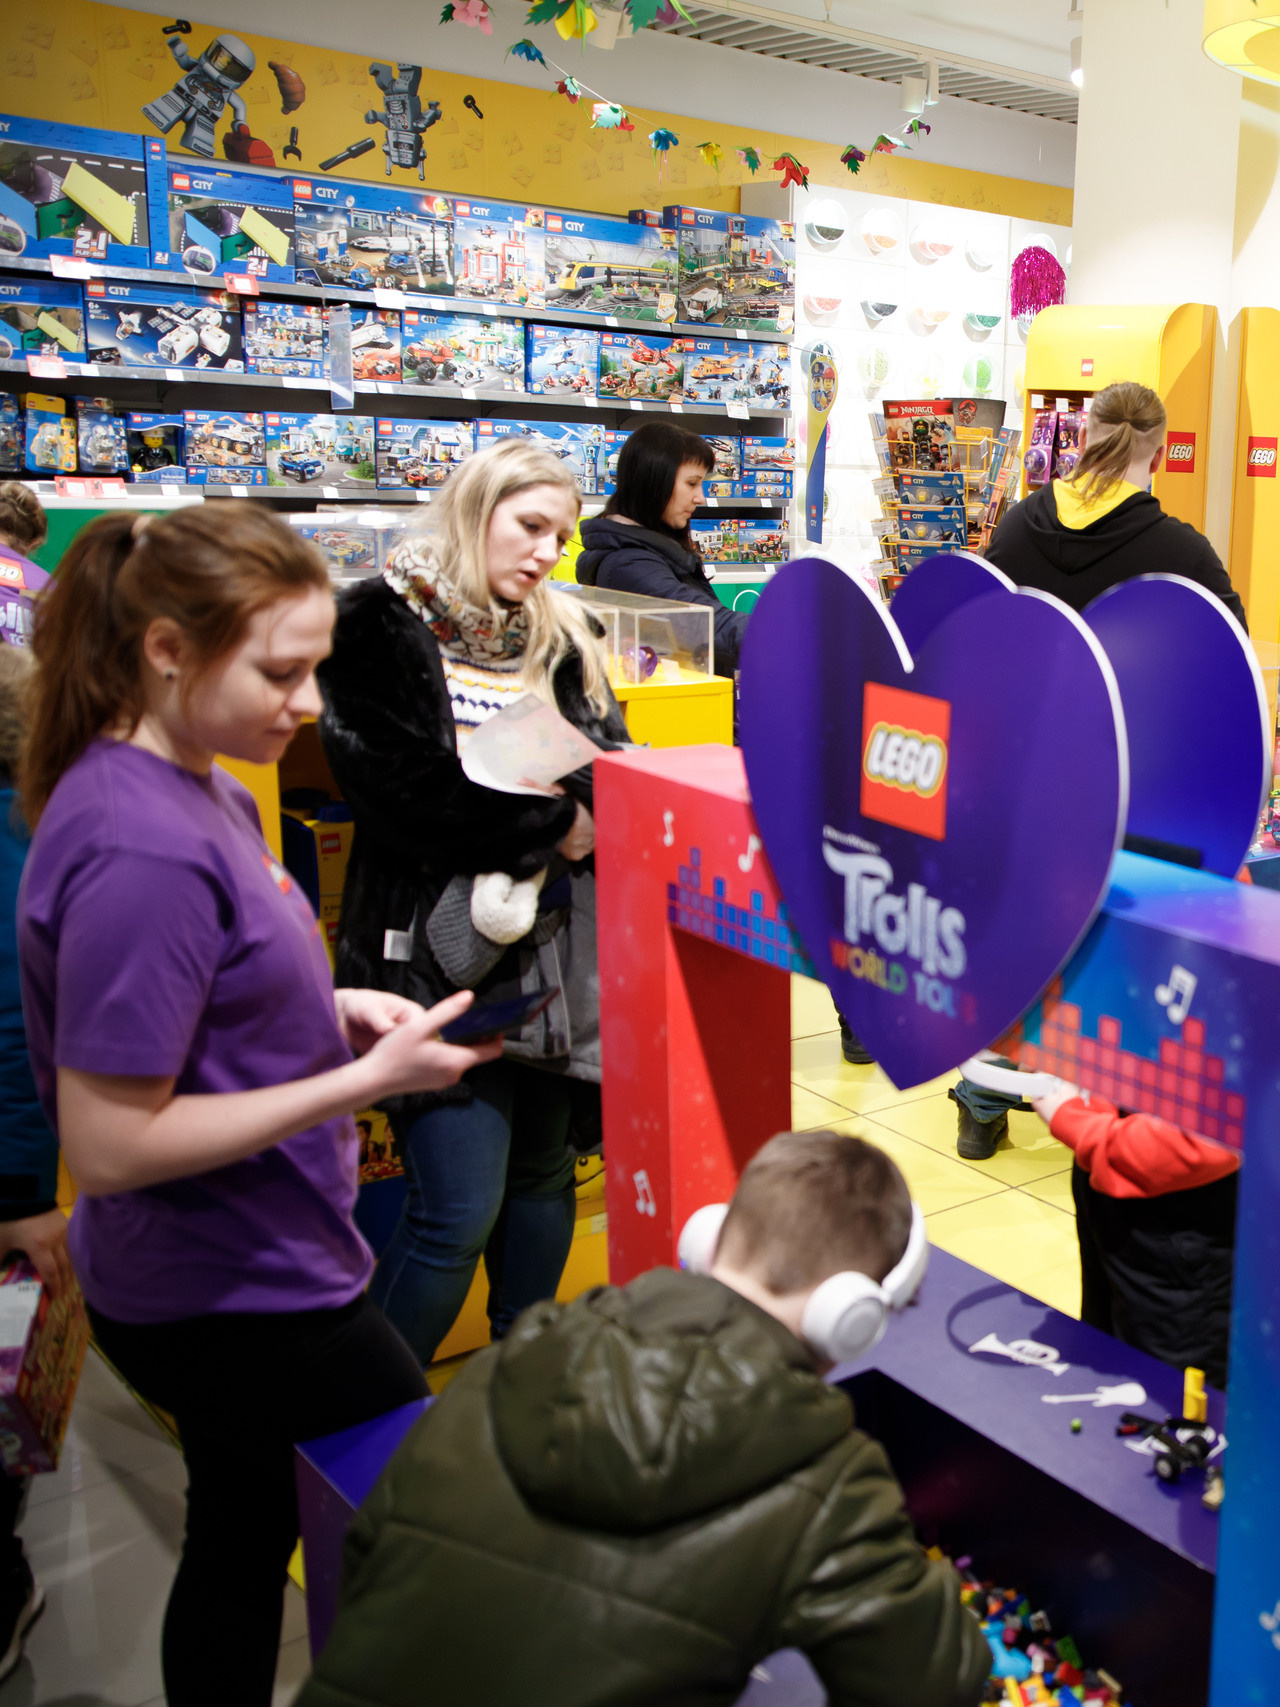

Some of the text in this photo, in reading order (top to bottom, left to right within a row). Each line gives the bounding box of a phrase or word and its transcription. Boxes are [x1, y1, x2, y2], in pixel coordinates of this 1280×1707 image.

[192, 180, 213, 191] CITY
[315, 187, 339, 199] CITY
[472, 206, 490, 216] CITY
[697, 214, 714, 224] CITY
[565, 221, 585, 232] CITY
[108, 286, 130, 296] CITY
[421, 315, 439, 324] CITY
[546, 330, 559, 338] CITY
[614, 337, 627, 345] CITY
[281, 417, 297, 425] CITY
[395, 425, 412, 433] CITY
[495, 425, 511, 433] CITY
[1168, 444, 1194, 461] LEGO
[1249, 448, 1276, 466] LEGO
[864, 724, 945, 796] LEGO
[822, 839, 967, 980] Trolls
[829, 937, 908, 995] WORLD
